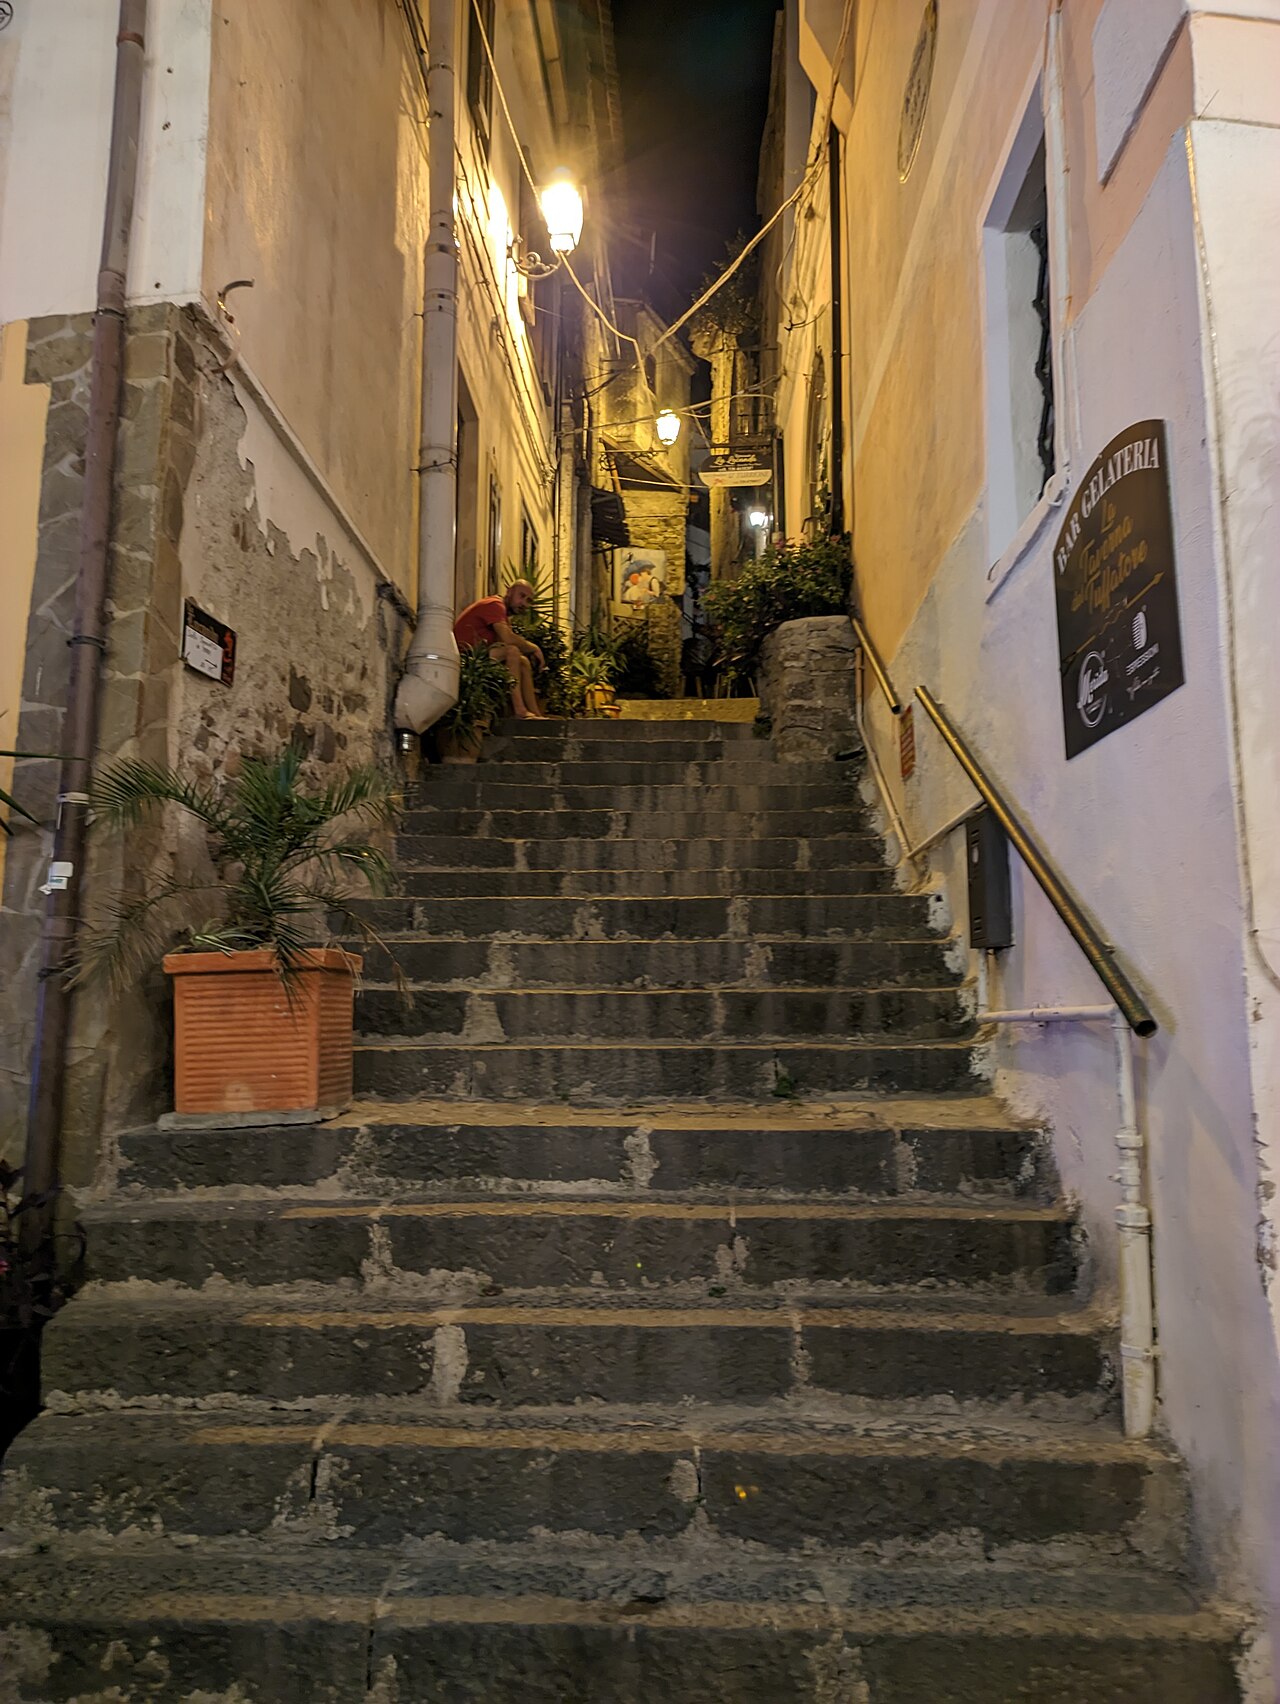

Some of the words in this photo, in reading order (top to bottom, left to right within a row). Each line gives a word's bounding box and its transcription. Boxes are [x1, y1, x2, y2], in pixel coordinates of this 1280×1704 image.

[1057, 511, 1081, 576] BAR
[1081, 437, 1160, 518] GELATERIA
[1101, 499, 1116, 533] La
[1080, 515, 1133, 583] Taverna
[1085, 540, 1147, 615] Tuffatore
